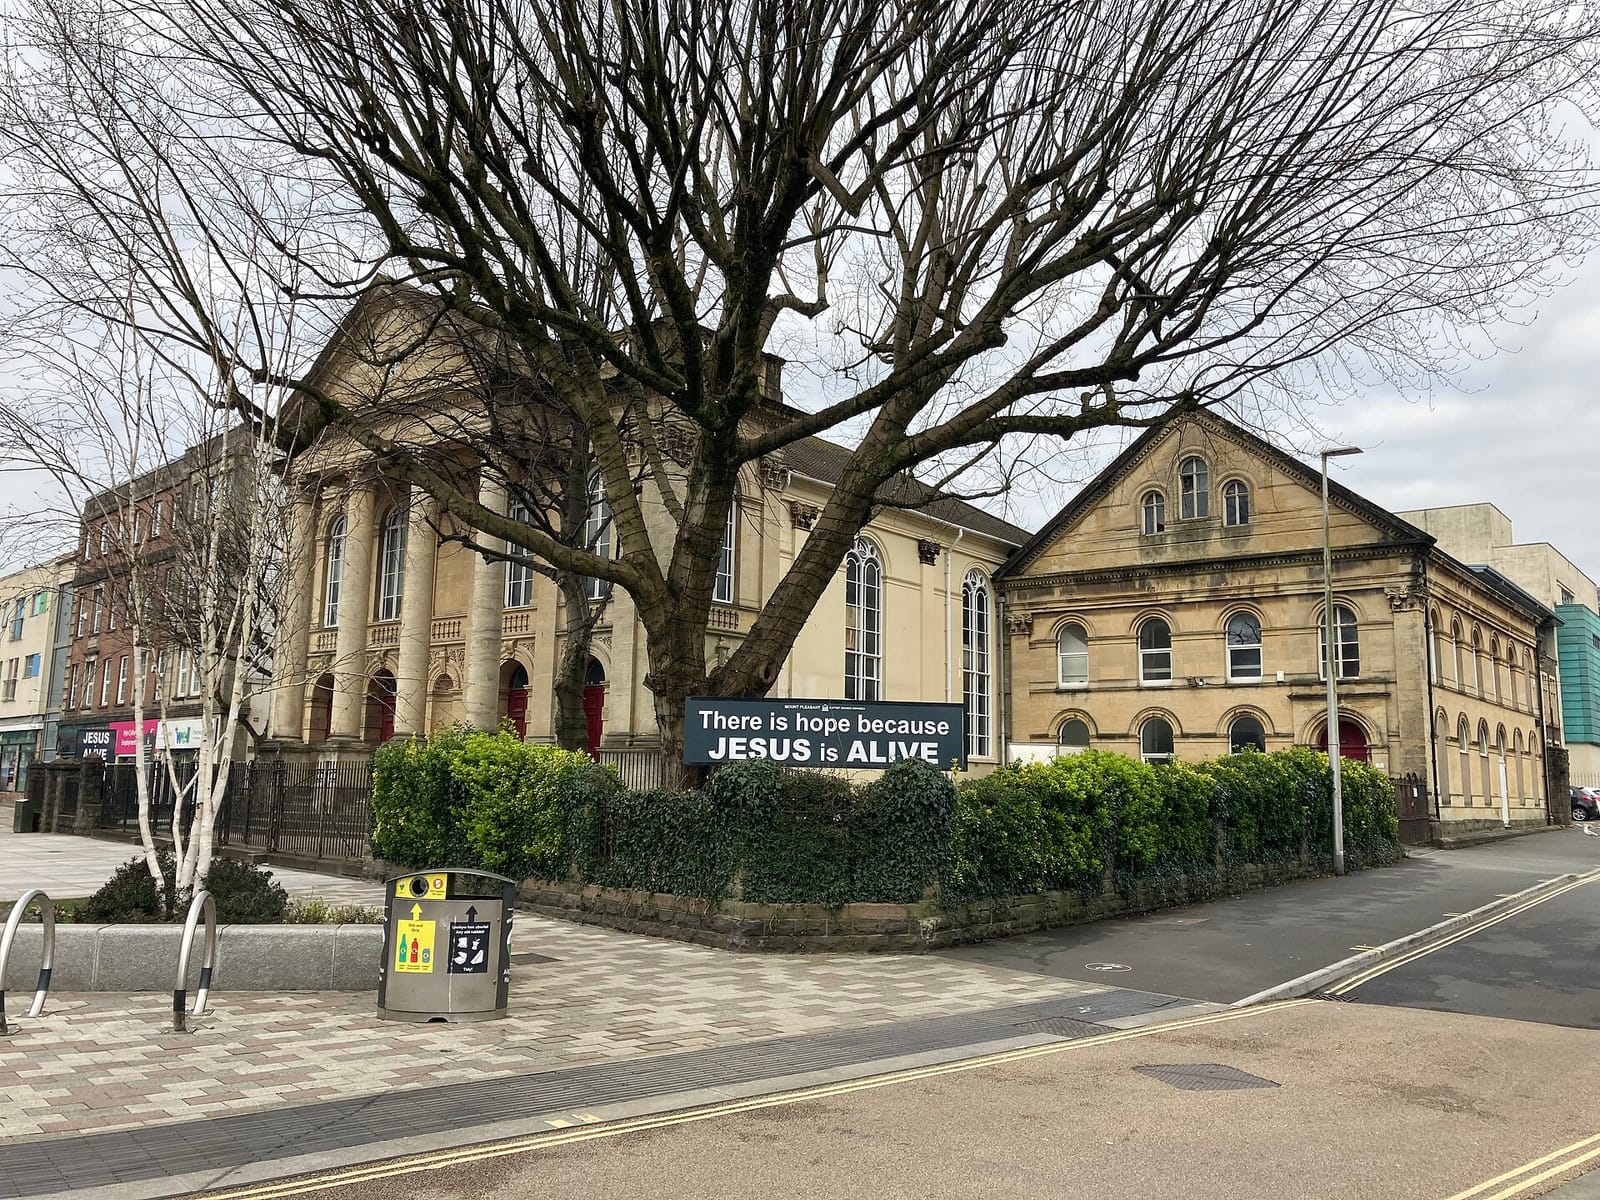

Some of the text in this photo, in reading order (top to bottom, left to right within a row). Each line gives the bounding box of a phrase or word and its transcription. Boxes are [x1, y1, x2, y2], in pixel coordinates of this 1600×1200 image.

[698, 710, 950, 737] There is hope because
[83, 732, 110, 744] JESUS
[708, 736, 939, 765] JESUS is ALIVE
